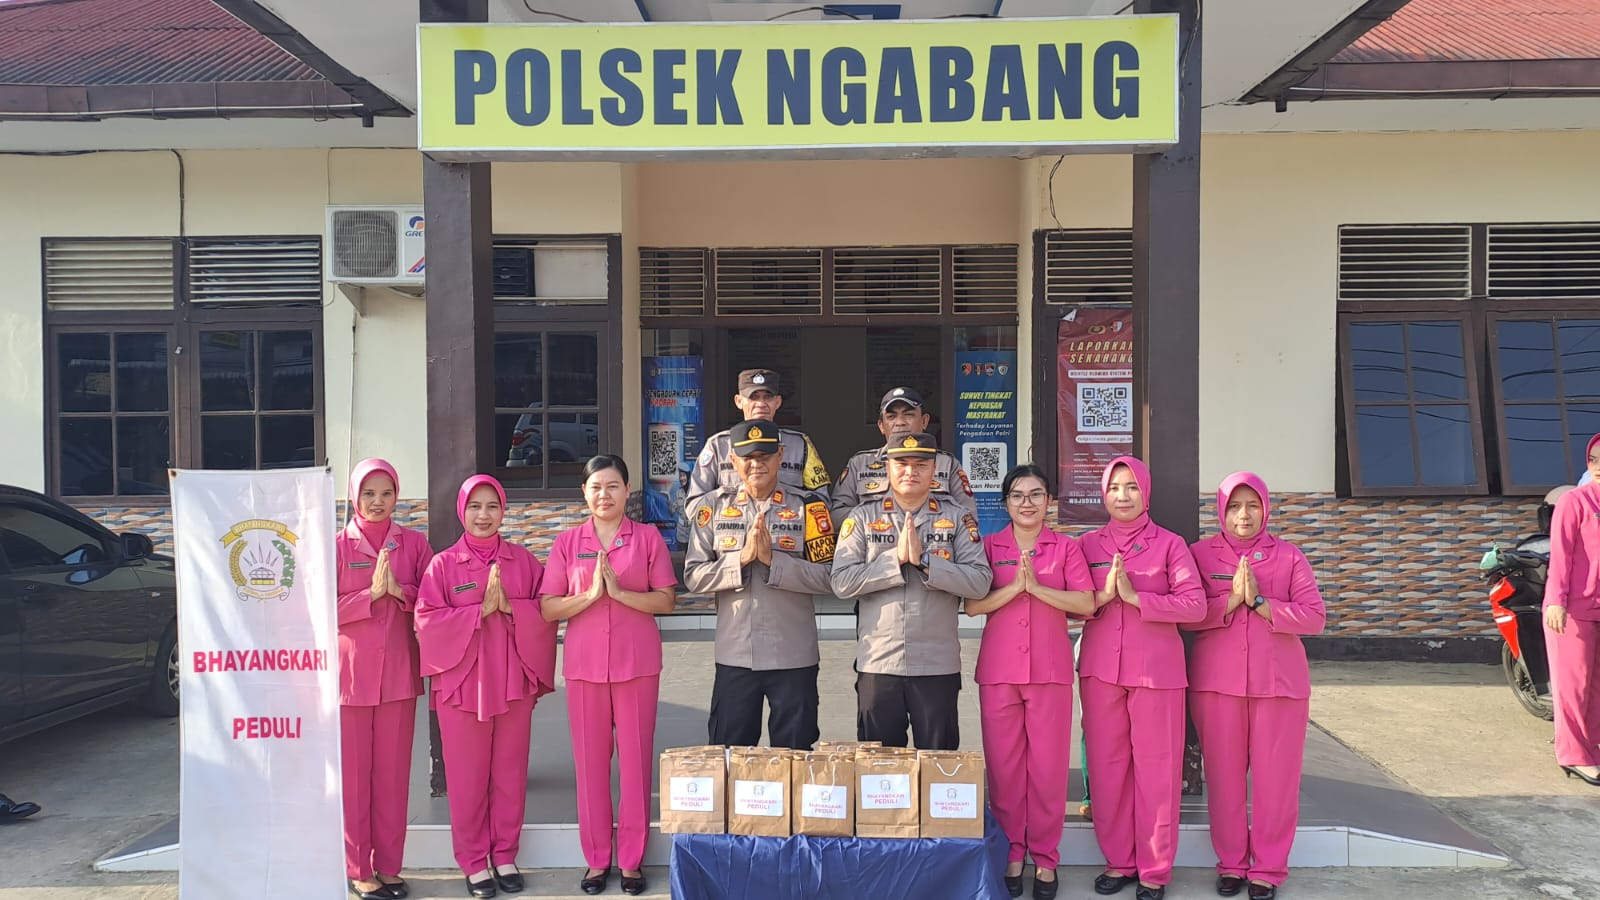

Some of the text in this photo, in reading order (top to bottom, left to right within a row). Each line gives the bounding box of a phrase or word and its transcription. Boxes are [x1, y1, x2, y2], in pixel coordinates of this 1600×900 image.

[454, 40, 1140, 127] POLSEK NGABANG
[1069, 353, 1133, 364] SEKARANG
[984, 391, 1013, 400] TINGKAT
[968, 401, 1003, 410] KEPUASAN
[771, 523, 803, 532] POLRI
[193, 649, 327, 673] BHAYANGKARI
[233, 716, 302, 740] PEDULI
